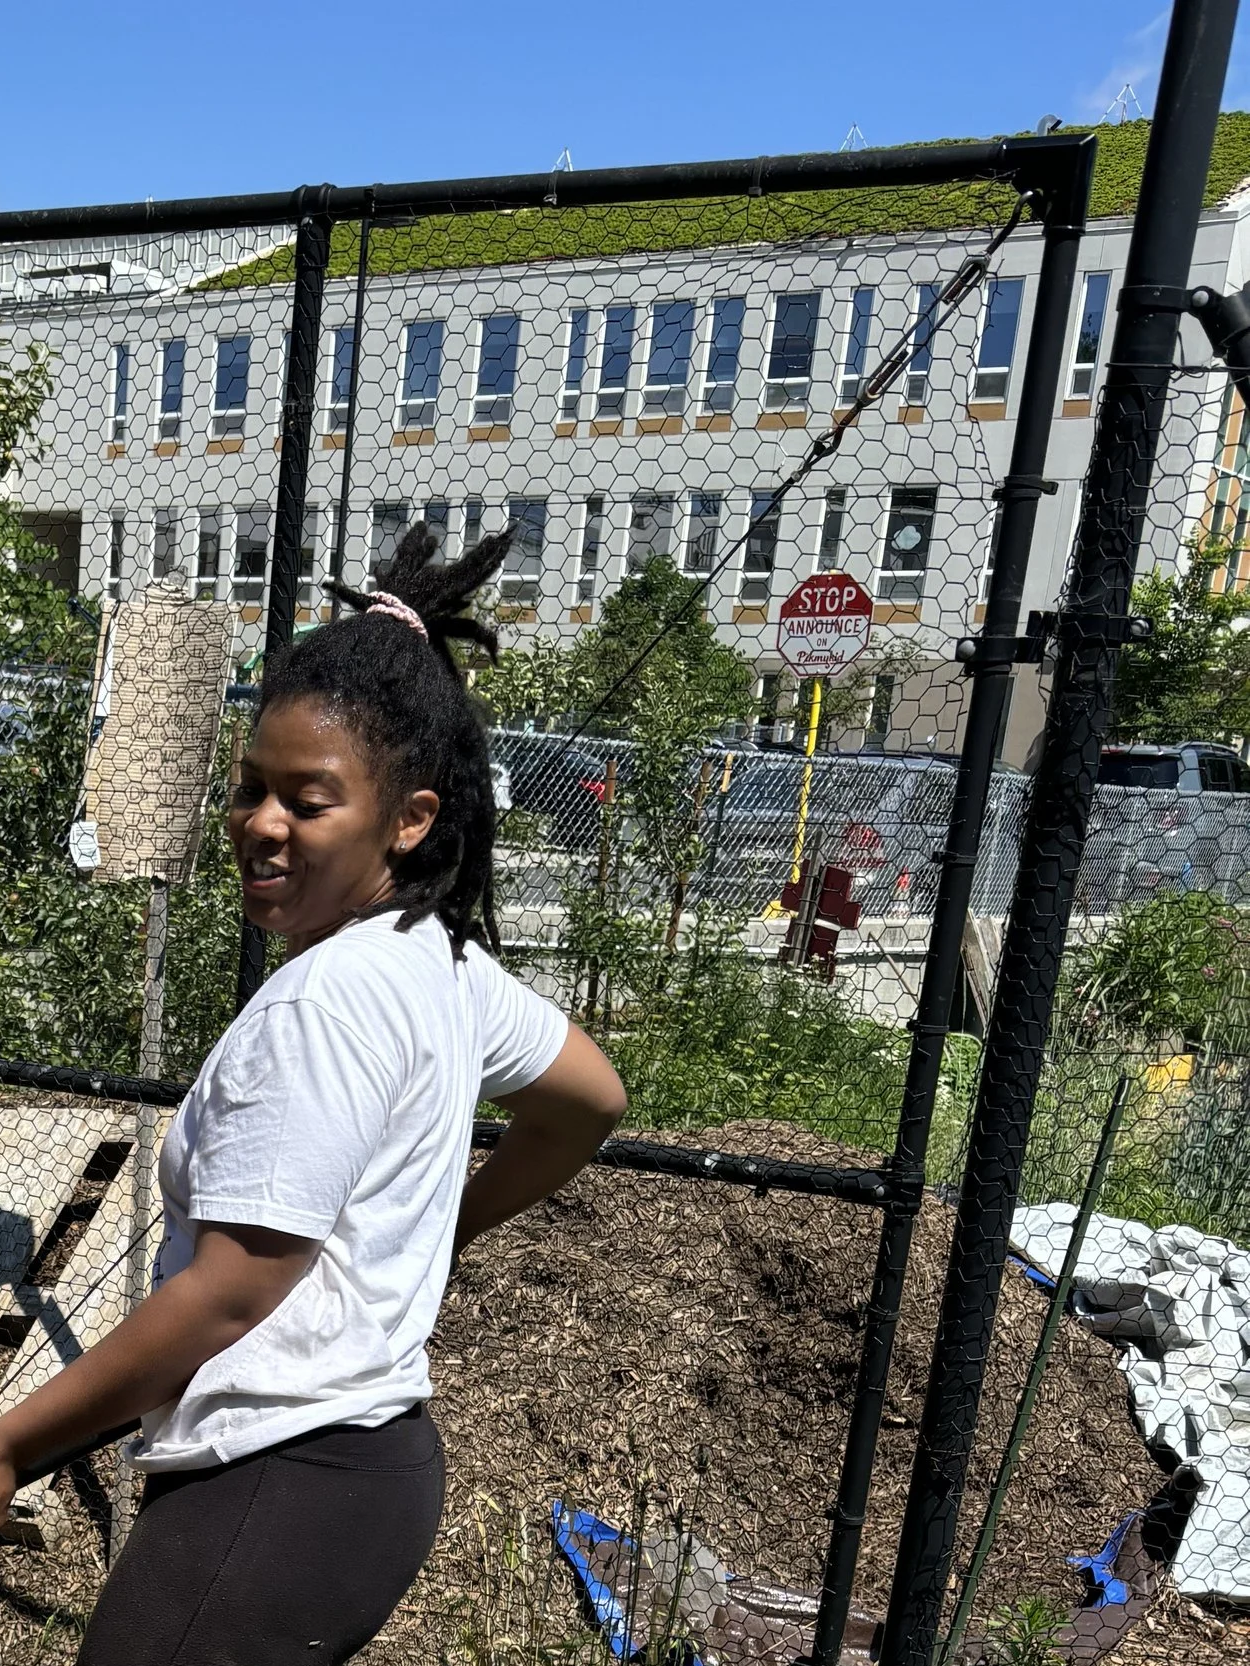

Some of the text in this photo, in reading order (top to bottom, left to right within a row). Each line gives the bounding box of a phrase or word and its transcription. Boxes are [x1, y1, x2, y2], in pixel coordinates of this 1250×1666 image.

[798, 586, 857, 613] STOP
[787, 618, 862, 635] ANNOUNCE
[816, 638, 827, 647] ON
